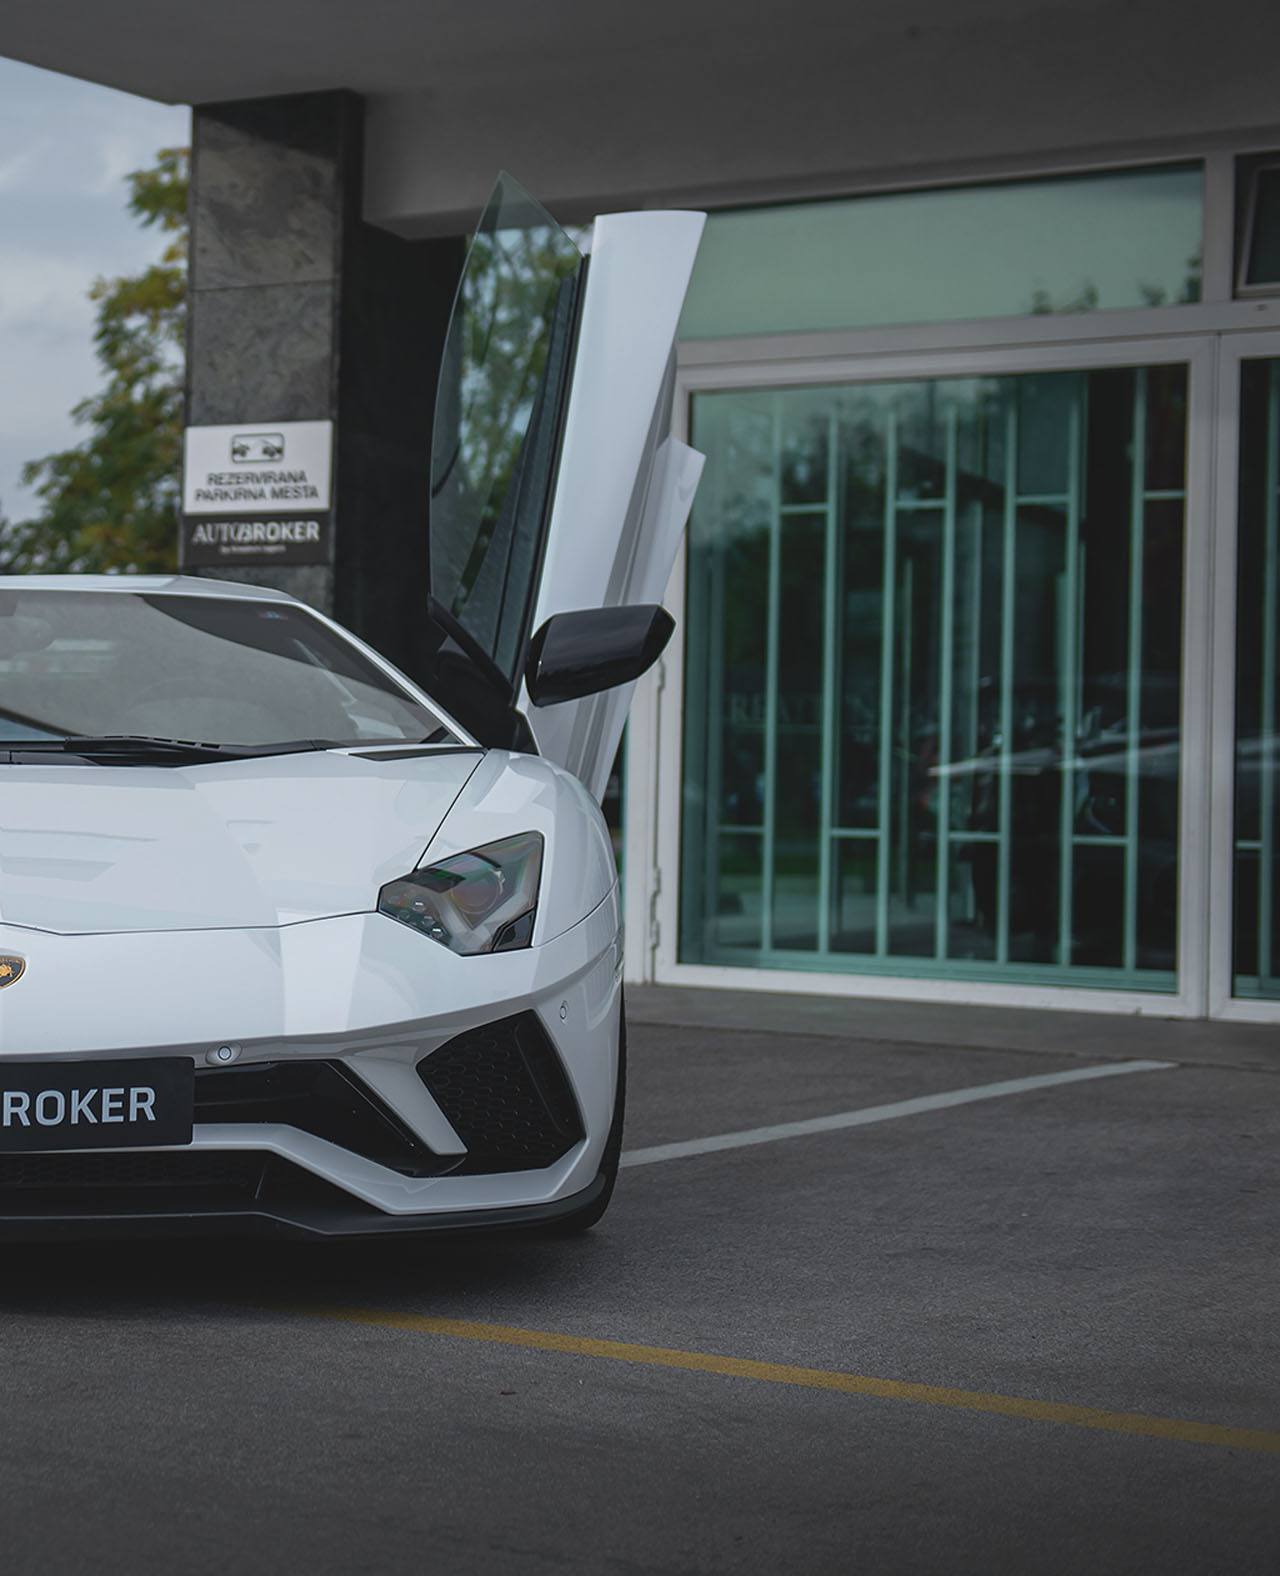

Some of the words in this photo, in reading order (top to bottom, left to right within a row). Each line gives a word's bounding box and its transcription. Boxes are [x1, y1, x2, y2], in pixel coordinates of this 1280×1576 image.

[207, 470, 308, 486] REZERVIRANA
[195, 487, 267, 502] PARKIRNA
[270, 485, 320, 500] MESTA
[192, 521, 320, 544] AUTOBROKER
